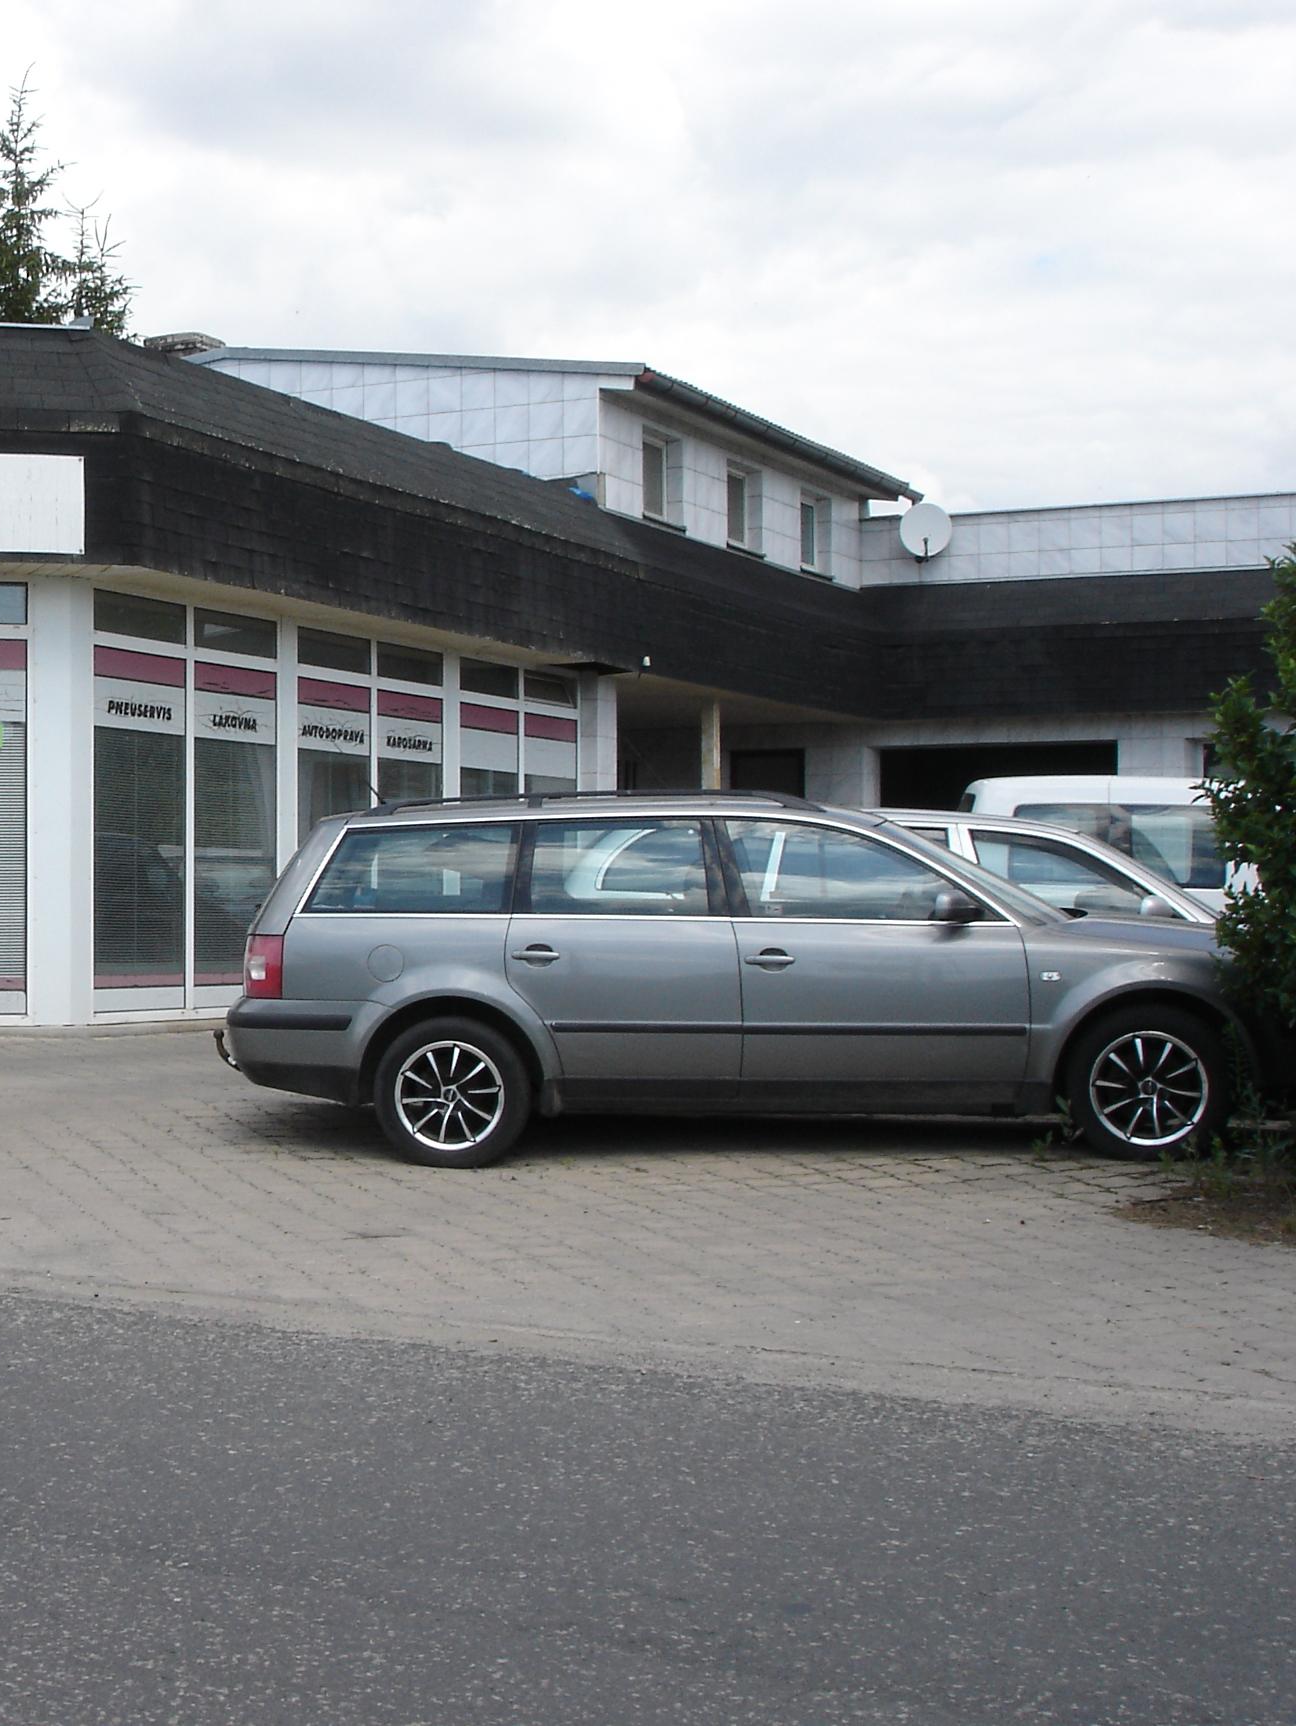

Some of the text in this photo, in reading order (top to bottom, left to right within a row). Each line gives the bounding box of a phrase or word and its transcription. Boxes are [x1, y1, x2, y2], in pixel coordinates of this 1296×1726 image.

[107, 700, 172, 721] PNEUSERVIS
[212, 714, 257, 732] LAKOVNA
[301, 724, 364, 745] AUTODOPRAVA
